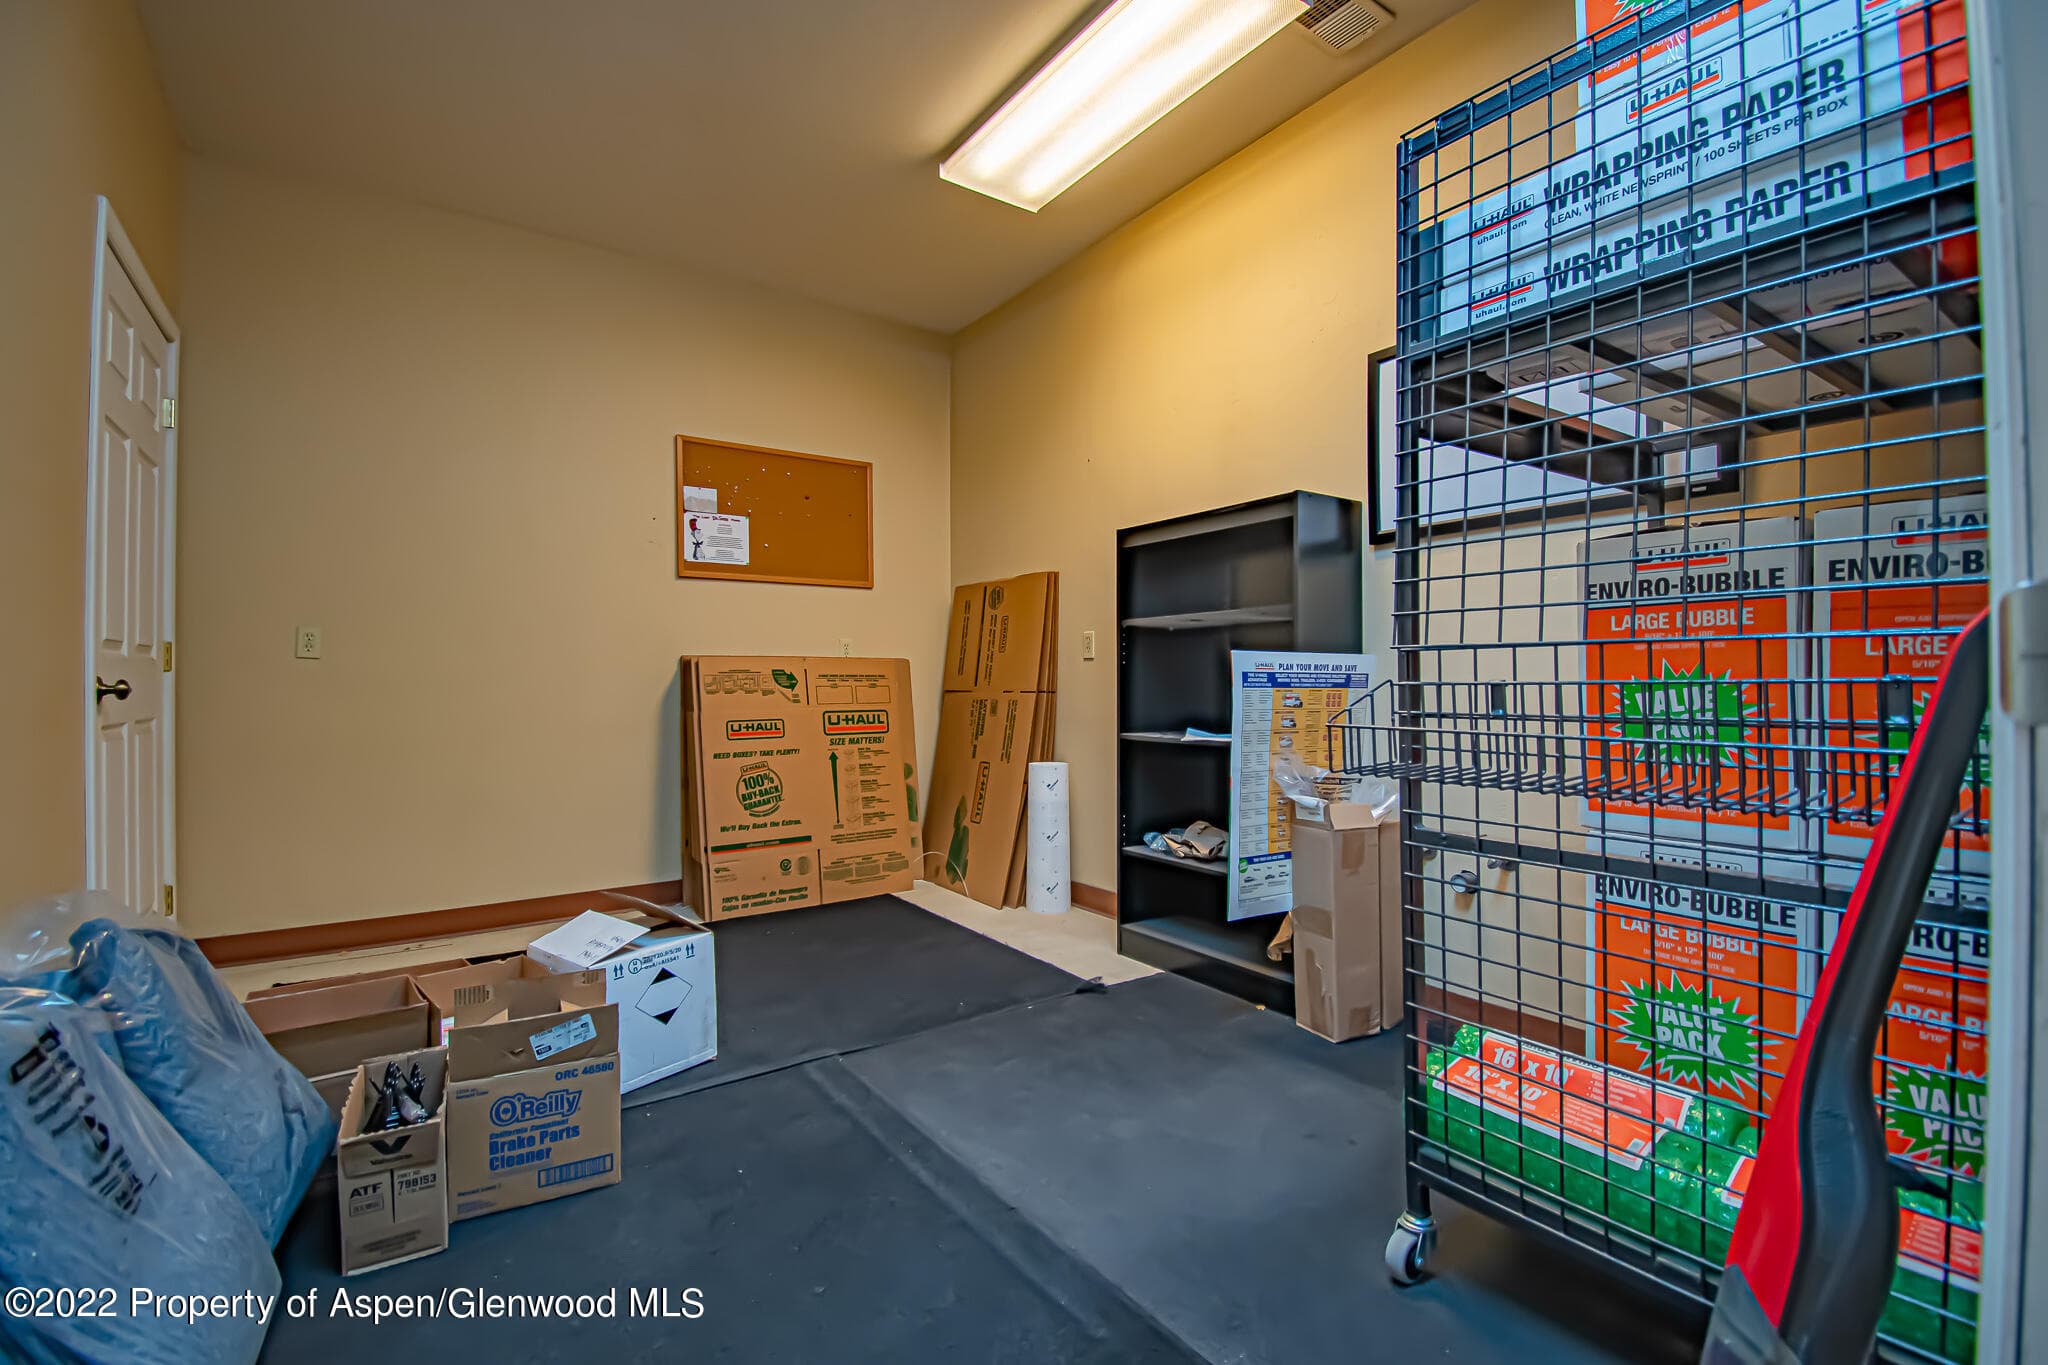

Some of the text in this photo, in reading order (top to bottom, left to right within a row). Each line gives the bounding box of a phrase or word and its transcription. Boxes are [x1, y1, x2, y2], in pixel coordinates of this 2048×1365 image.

[1543, 58, 1848, 214] WRAPPING PAPER
[1544, 206, 1582, 229] CLEAN,
[1584, 190, 1620, 213] WHITE
[1622, 160, 1690, 196] NEWSPRINT
[1703, 145, 1725, 164] 100
[1727, 123, 1781, 154] SHEETS
[1784, 111, 1813, 131] PER
[1817, 95, 1849, 118] BOX
[1476, 218, 1528, 246] uhaul.om
[1543, 208, 1713, 293] WRAPPING
[1724, 160, 1853, 235] PAPER
[1475, 296, 1528, 319] uhaul.om
[1828, 549, 1988, 583] ENVIRO-B
[1611, 612, 1670, 632] LARGE
[1864, 635, 1949, 657] LARGE
[1278, 663, 1294, 671] PLAN
[1296, 663, 1312, 672] YOUR
[1314, 664, 1330, 672] MOVE
[1331, 664, 1343, 672] AND
[1344, 664, 1358, 672] SAVE
[1634, 683, 1714, 715] VALUE
[731, 720, 781, 733] U-HAUL
[827, 713, 885, 726] U-HAUL
[829, 736, 885, 746] SIZE MATTERS!
[741, 771, 775, 791] 100%
[741, 784, 780, 802] BUY-BACK
[975, 764, 988, 821] U-HAUL
[1594, 874, 1798, 929] ENVIRO-BUBBLE
[1645, 999, 1728, 1034] VALUE
[1655, 1023, 1727, 1061] PACK
[555, 1061, 615, 1082] ORC 46580
[493, 1093, 579, 1124] O'Reilly
[489, 1124, 580, 1156] Brake Parts
[489, 1146, 553, 1172] Cleaner
[349, 1182, 383, 1200] ATF
